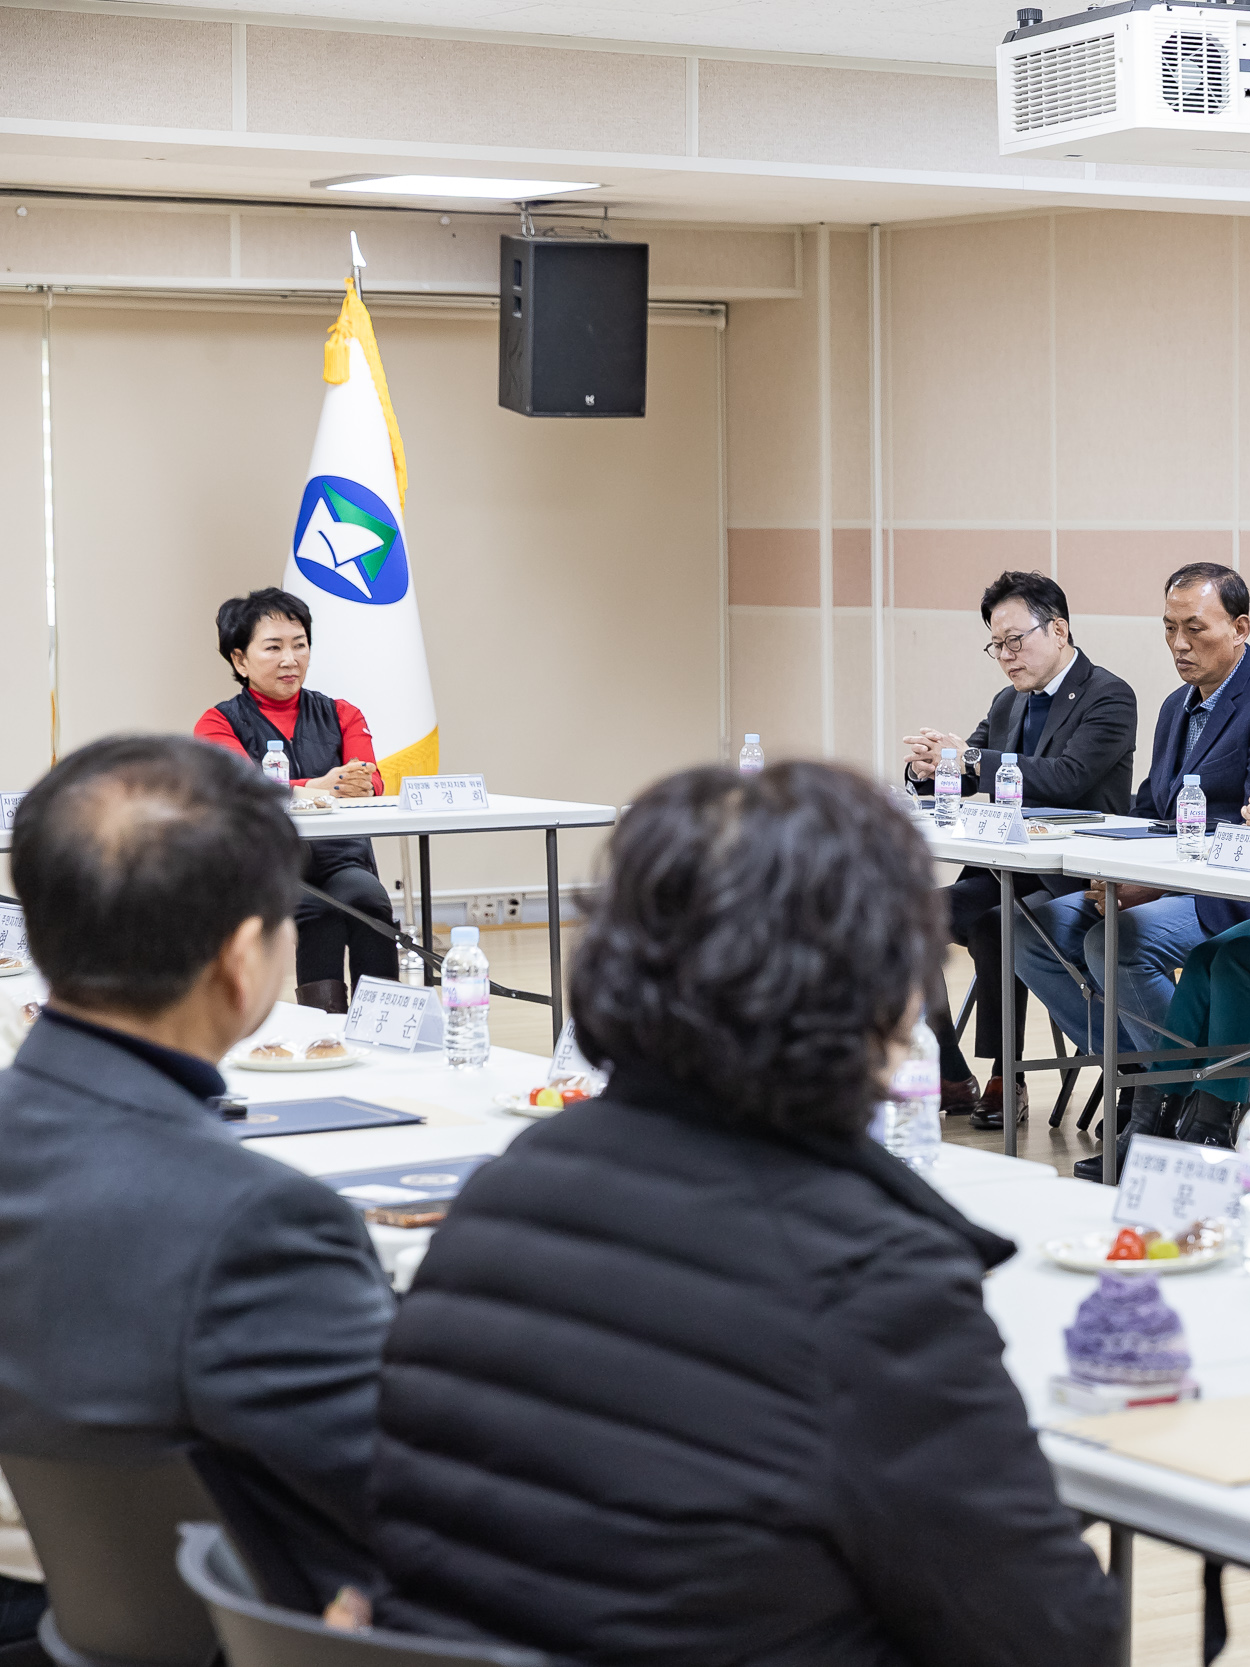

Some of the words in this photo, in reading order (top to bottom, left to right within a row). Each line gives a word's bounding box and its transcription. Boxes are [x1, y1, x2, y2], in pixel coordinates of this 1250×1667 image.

[410, 791, 423, 806] 임
[442, 790, 454, 804] 경
[472, 789, 484, 803] 희
[1216, 831, 1233, 842] 자양3동
[1212, 843, 1223, 859] 정
[1234, 846, 1243, 862] 용
[357, 989, 378, 1003] 자양3동
[379, 992, 411, 1008] 주민자치회
[412, 997, 426, 1010] 위원
[351, 1005, 363, 1030] 박
[375, 1010, 390, 1033] 공
[402, 1014, 417, 1039] 순
